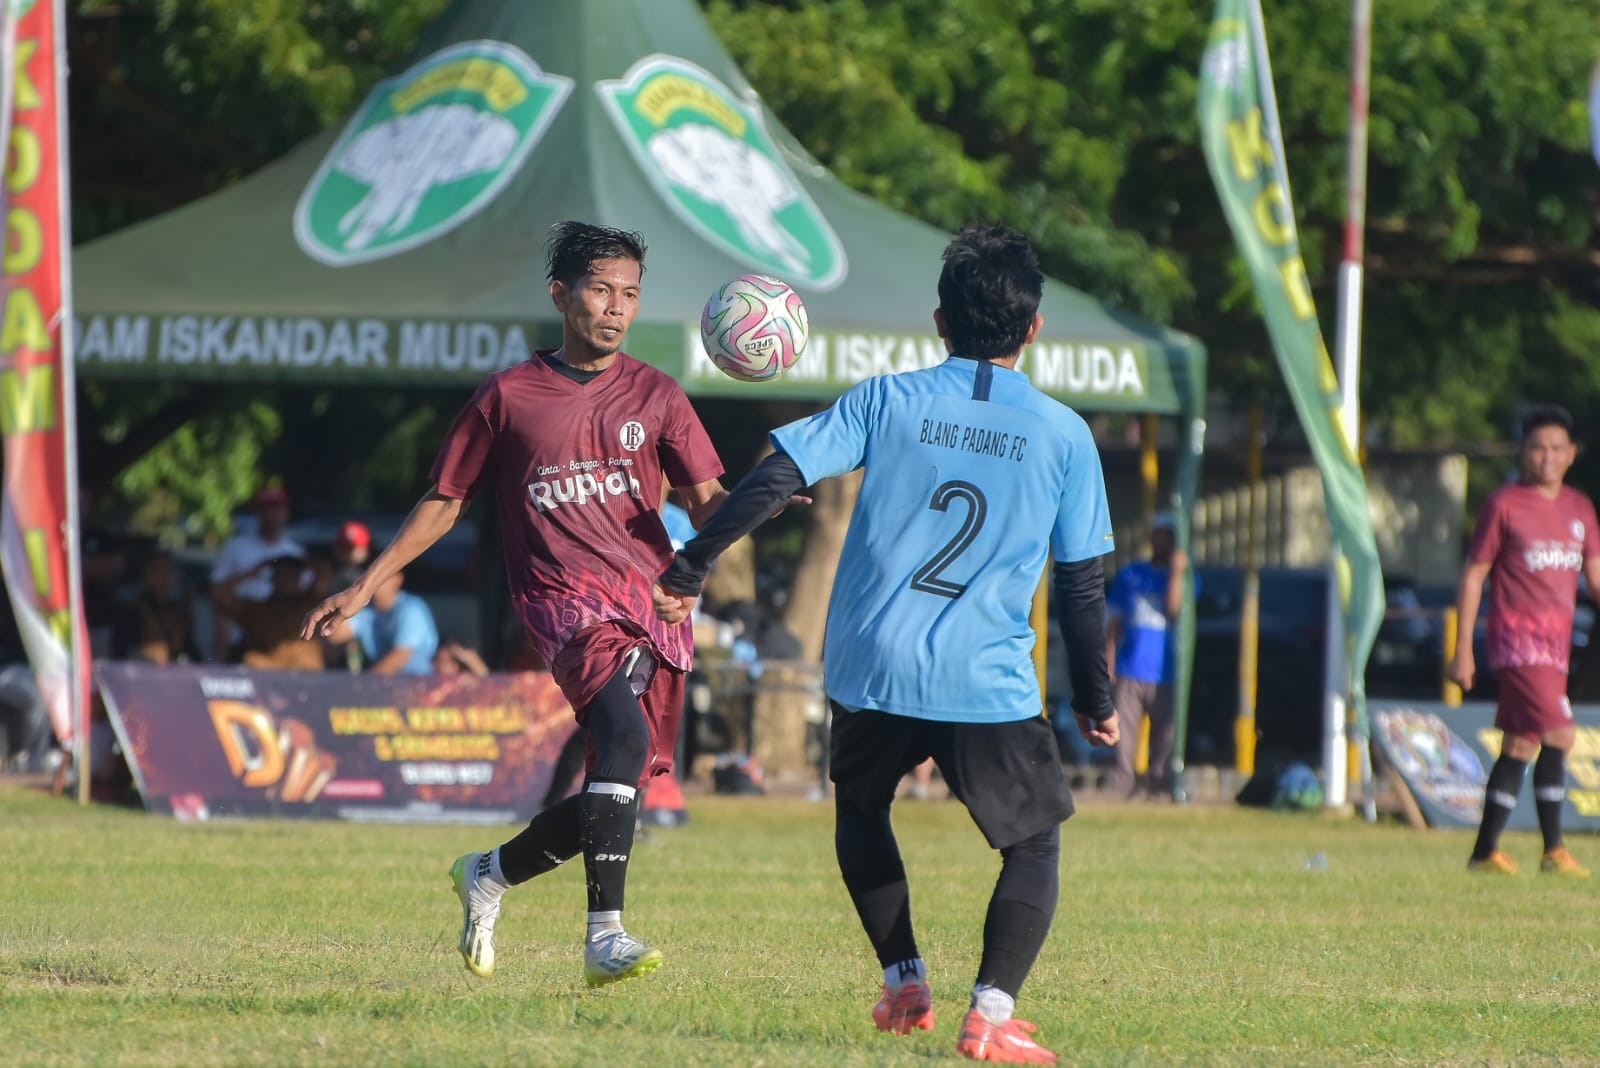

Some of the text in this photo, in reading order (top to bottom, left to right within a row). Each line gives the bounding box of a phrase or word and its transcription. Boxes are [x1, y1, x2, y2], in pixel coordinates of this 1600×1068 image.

[158, 315, 389, 368] ISKANDAR
[399, 320, 529, 373] MUDA
[744, 337, 774, 351] SPECS
[1030, 344, 1144, 396] MUDA
[919, 418, 1027, 462] BLANG PADANG FC
[537, 465, 561, 476] Cinta
[569, 460, 600, 471] Bangga
[528, 469, 643, 513] Rupiah
[910, 479, 988, 600] 2
